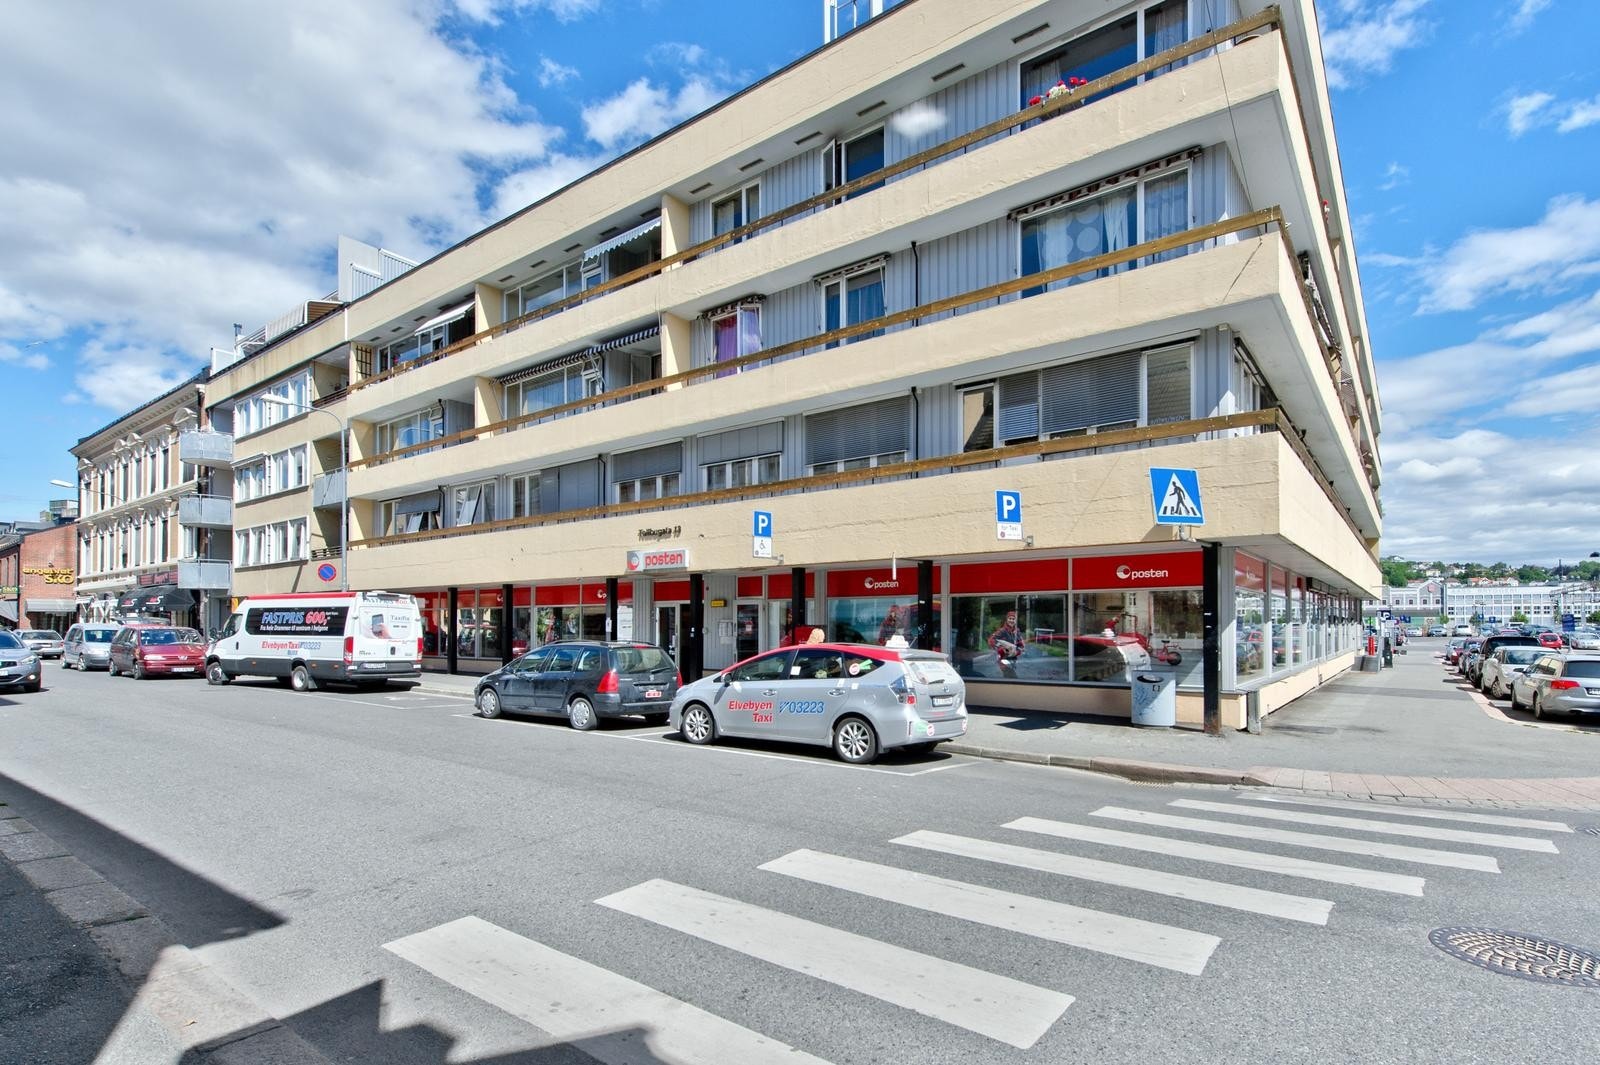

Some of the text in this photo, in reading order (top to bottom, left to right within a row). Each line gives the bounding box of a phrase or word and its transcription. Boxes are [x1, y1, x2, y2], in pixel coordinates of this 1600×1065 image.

[1002, 495, 1016, 519] P
[758, 514, 768, 534] P
[645, 551, 683, 568] posten
[45, 574, 75, 585] SKO
[1131, 569, 1169, 580] posten
[874, 580, 899, 590] posten
[261, 611, 304, 624] FASTPRIS
[261, 641, 288, 650] Elvebyen
[728, 700, 773, 711] Elvebyen
[789, 701, 824, 713] 03223
[752, 713, 773, 722] Taxi
